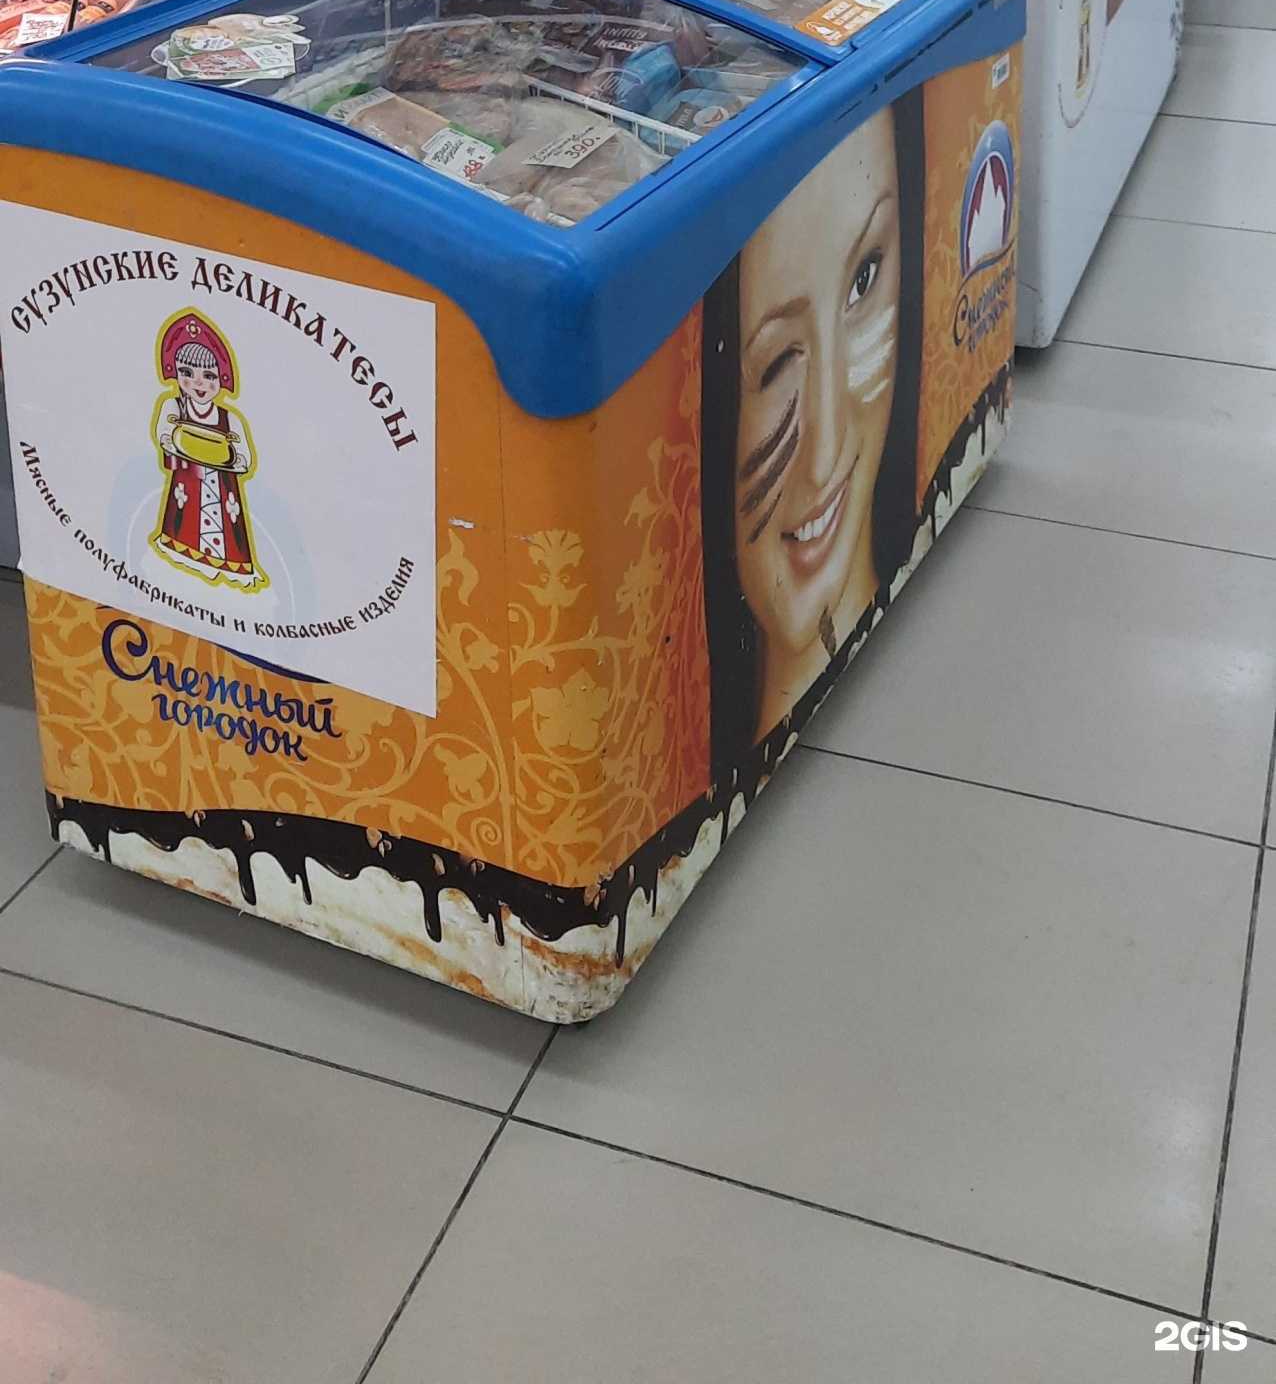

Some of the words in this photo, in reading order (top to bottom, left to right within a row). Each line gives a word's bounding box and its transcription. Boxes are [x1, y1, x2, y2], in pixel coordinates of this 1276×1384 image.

[9, 250, 179, 335] СУЗУНСКИЕ
[190, 257, 419, 453] ДЕЛИКАТЕСЫ
[102, 619, 342, 739] Снежный
[152, 694, 309, 762] городок
